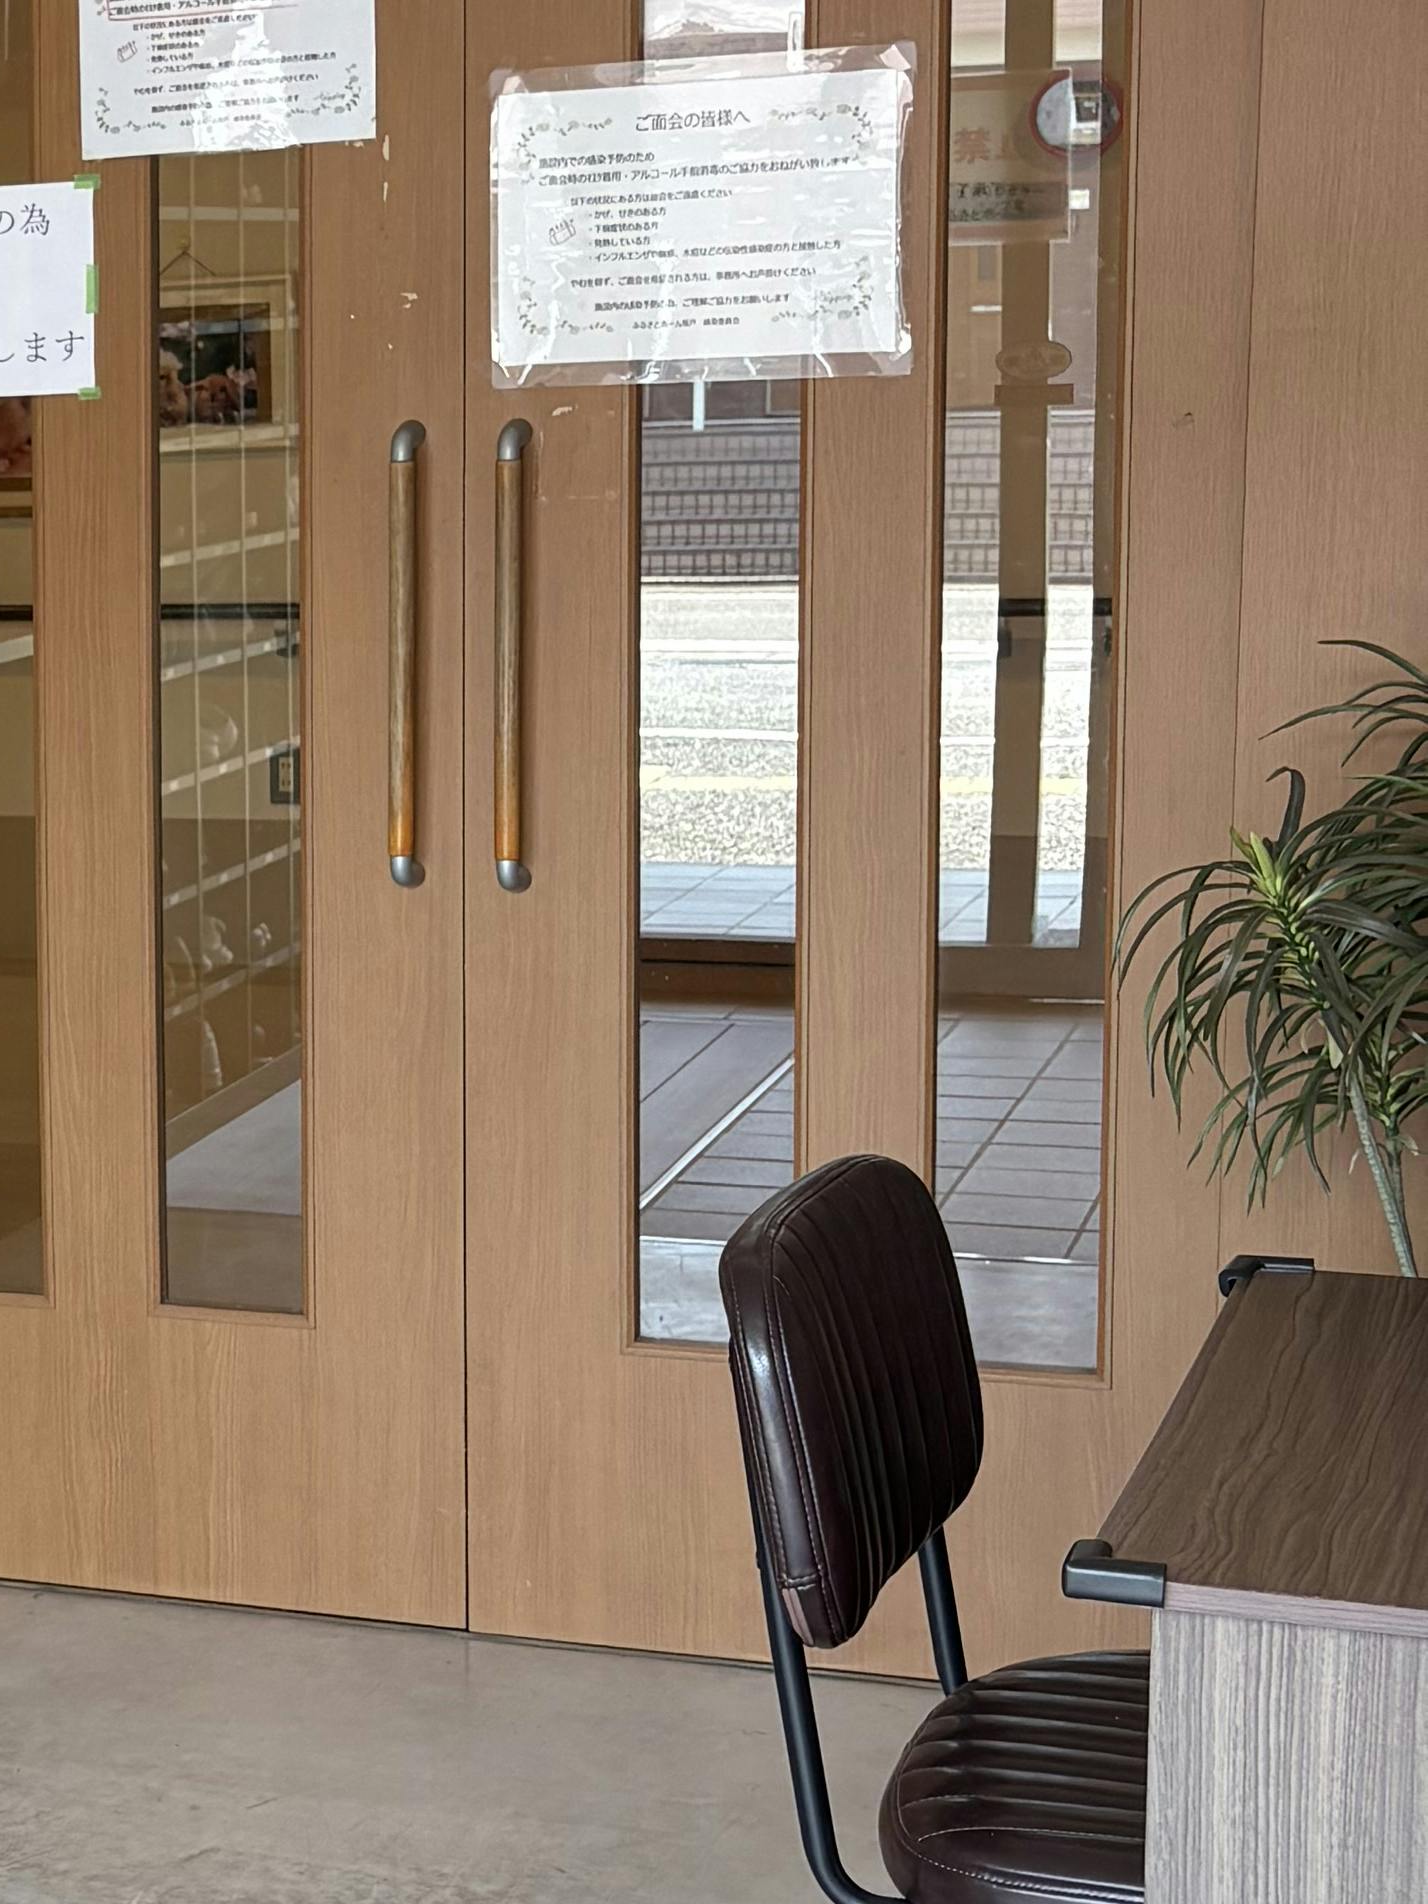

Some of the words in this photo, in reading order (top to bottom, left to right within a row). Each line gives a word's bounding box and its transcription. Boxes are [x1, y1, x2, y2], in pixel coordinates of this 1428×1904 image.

[636, 108, 751, 131] ご面会の皆様へ
